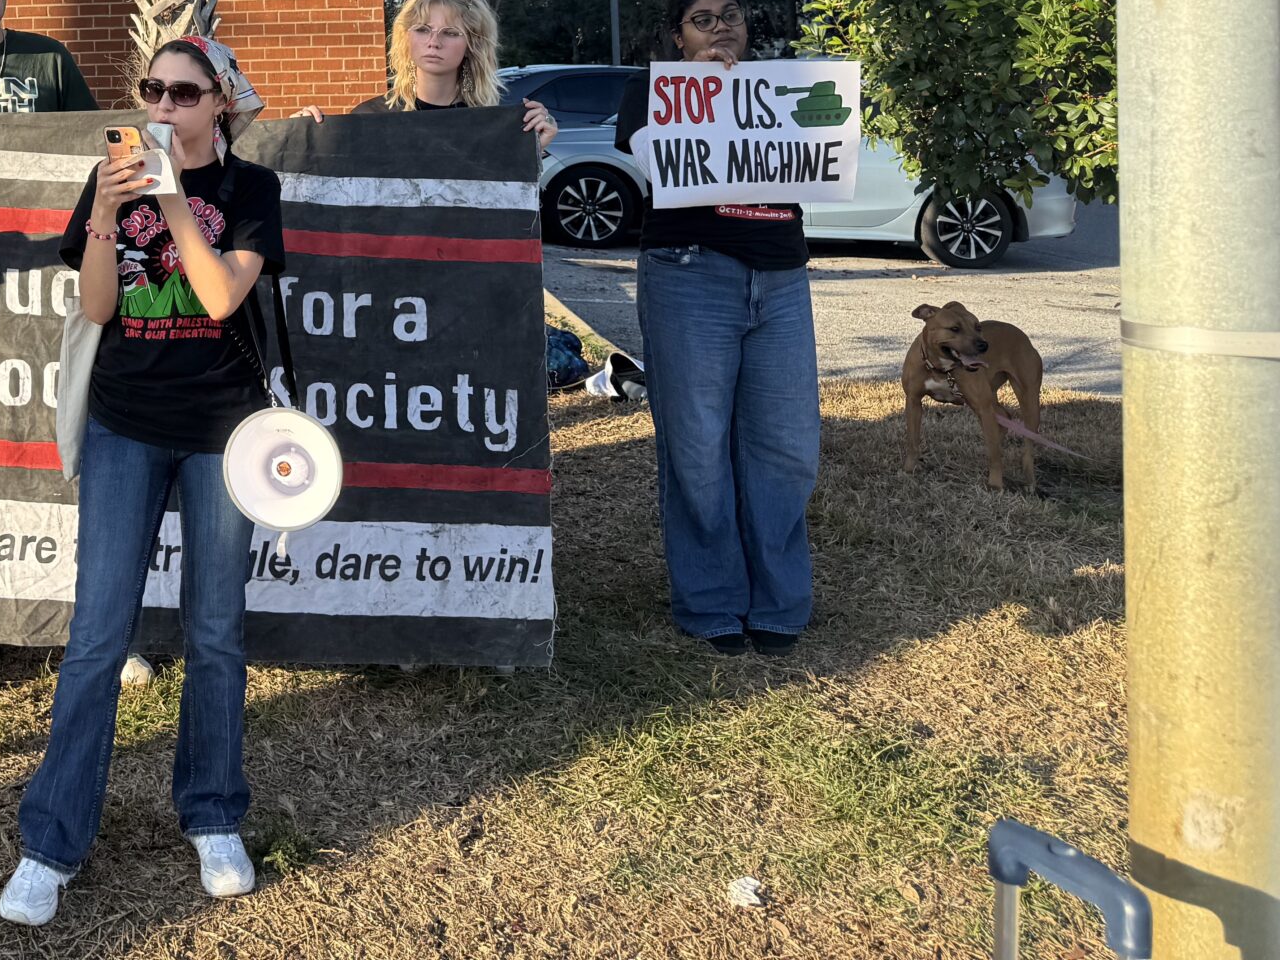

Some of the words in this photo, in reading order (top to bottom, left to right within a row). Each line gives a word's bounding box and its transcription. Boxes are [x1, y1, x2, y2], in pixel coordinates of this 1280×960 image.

[653, 75, 723, 126] STOP
[732, 78, 783, 130] U.S.
[652, 138, 719, 188] WAR
[726, 138, 843, 184] MACHINE
[122, 204, 157, 238] SDS
[145, 330, 167, 340] OUR
[147, 318, 173, 329] WITH
[392, 296, 428, 343] a
[315, 543, 402, 582] dare
[415, 547, 452, 582] to
[463, 548, 545, 584] win!
